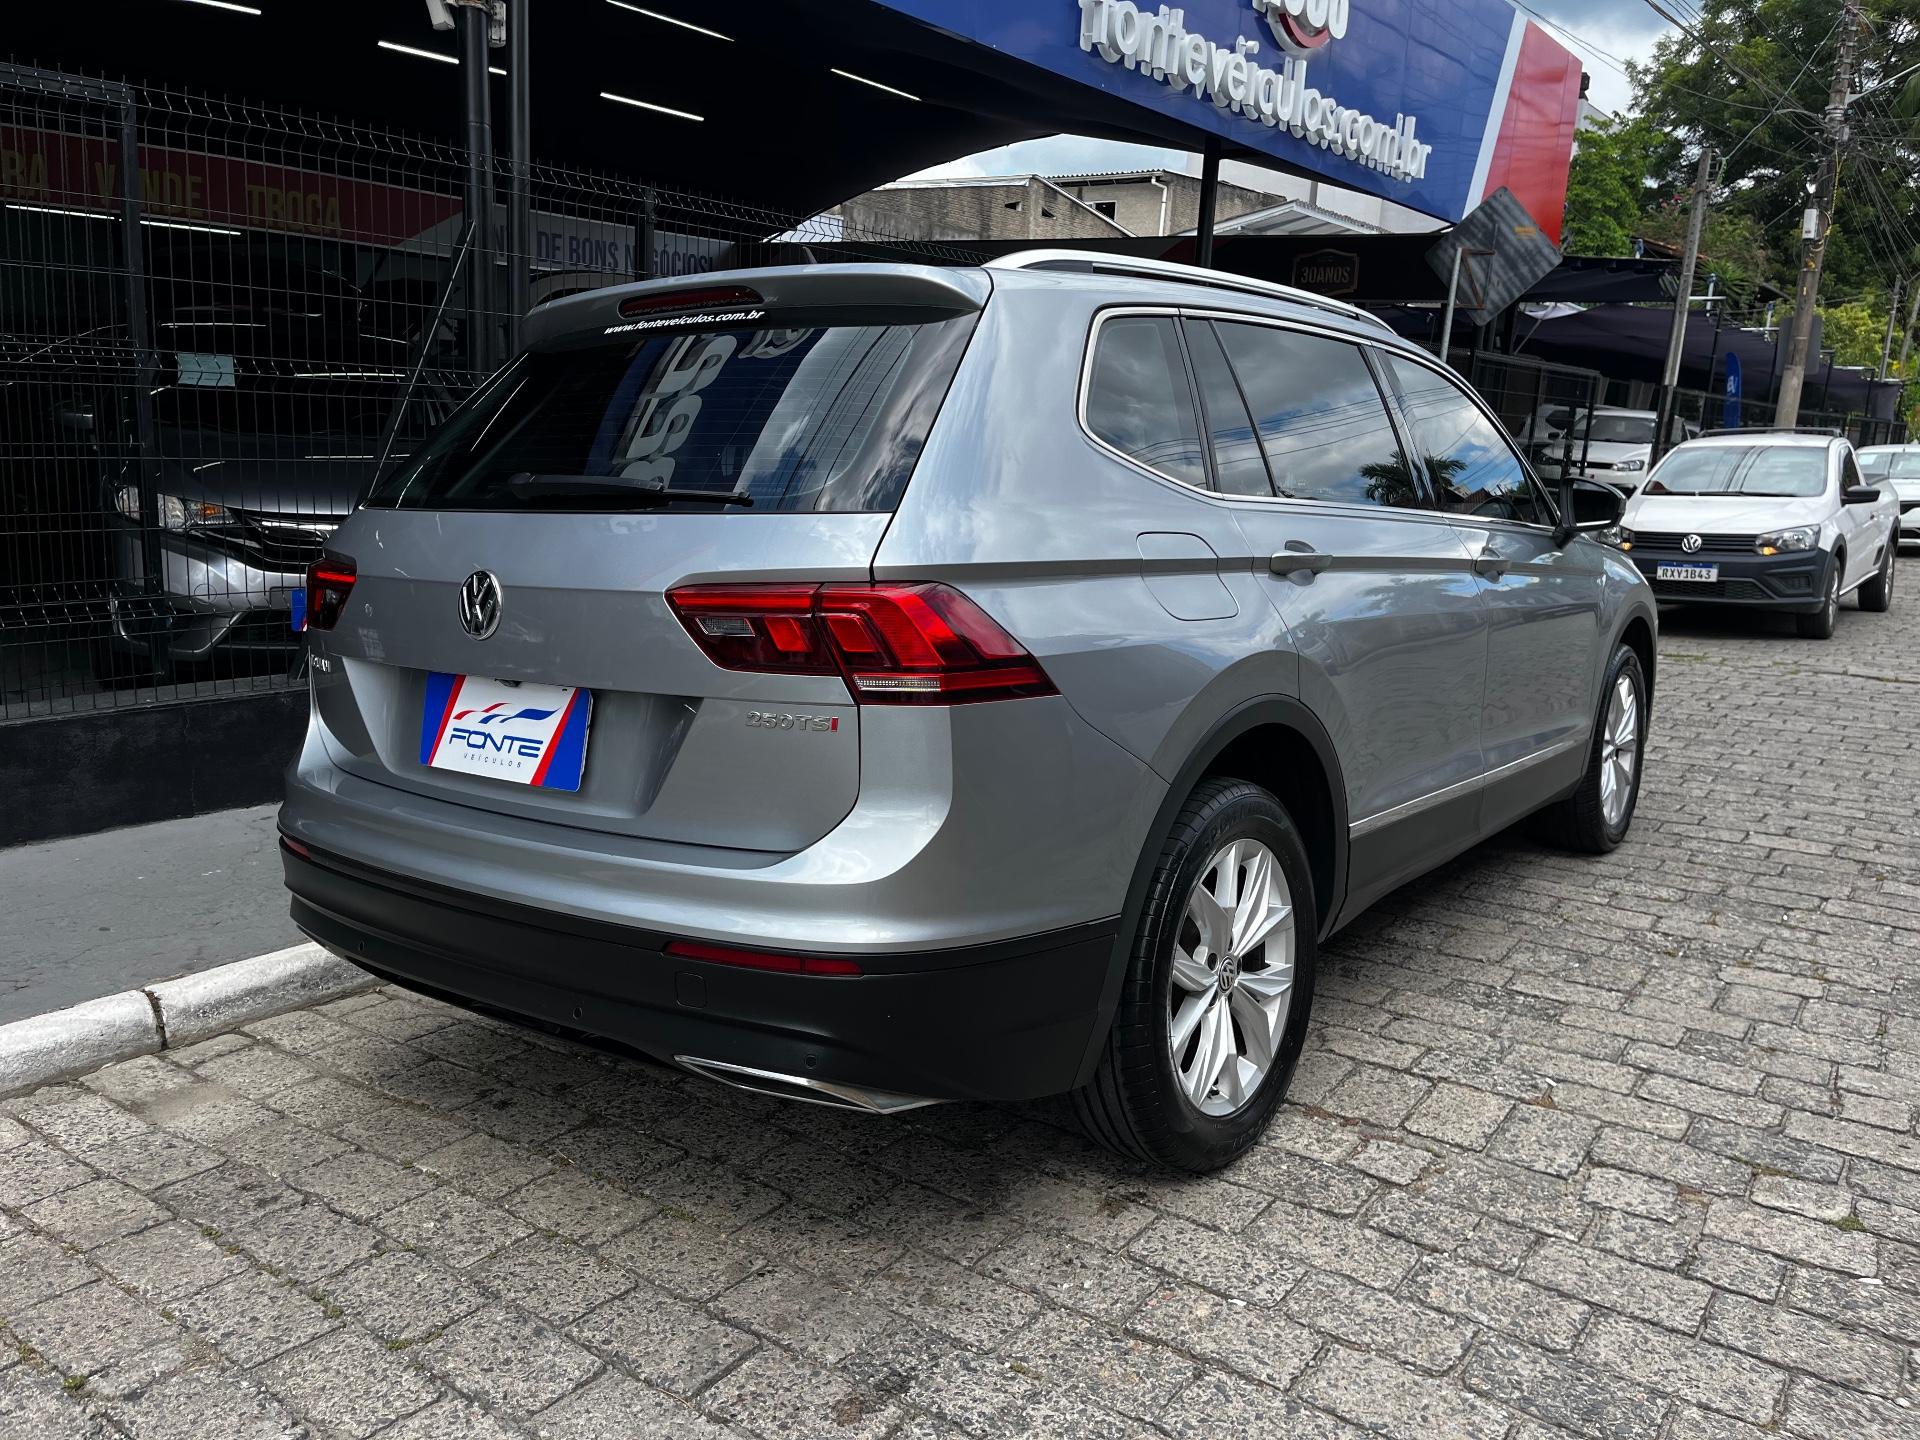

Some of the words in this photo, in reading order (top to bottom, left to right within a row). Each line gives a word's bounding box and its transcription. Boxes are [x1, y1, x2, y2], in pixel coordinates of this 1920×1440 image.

[94, 161, 205, 218] VNDE
[246, 184, 342, 238] TROCA
[536, 231, 562, 264] DE
[568, 235, 618, 271] BONS
[624, 243, 713, 280] NGÓCIOS!
[1662, 567, 1712, 580] RXY1B43
[744, 710, 840, 733] 250TSI
[448, 727, 544, 759] FONTE
